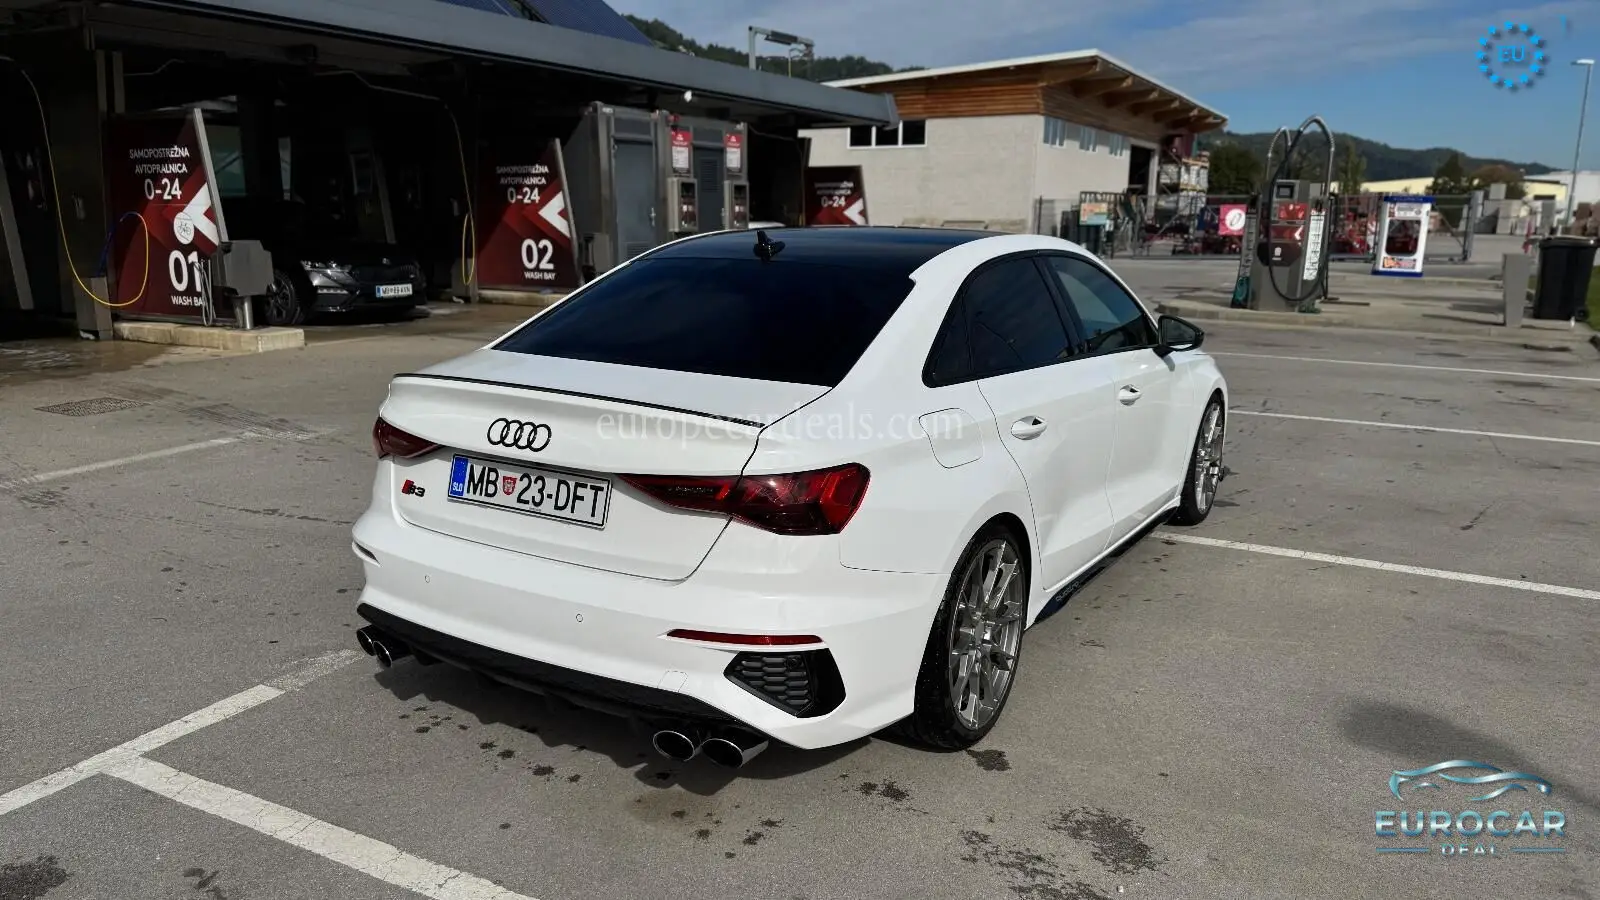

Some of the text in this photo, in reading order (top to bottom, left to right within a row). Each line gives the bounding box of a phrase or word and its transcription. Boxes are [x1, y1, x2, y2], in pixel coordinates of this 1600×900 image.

[129, 145, 190, 159] SAMOPOSTREŽNA
[135, 163, 188, 175] AVTOPRALNICA
[144, 177, 182, 200] 0-24
[507, 187, 540, 204] 0-24
[821, 196, 846, 207] 0-24
[521, 238, 554, 270] 02
[168, 249, 202, 292] 01
[524, 271, 556, 281] WASH BAY
[171, 295, 206, 307] WASH BA
[467, 464, 604, 518] MB 23-DFT
